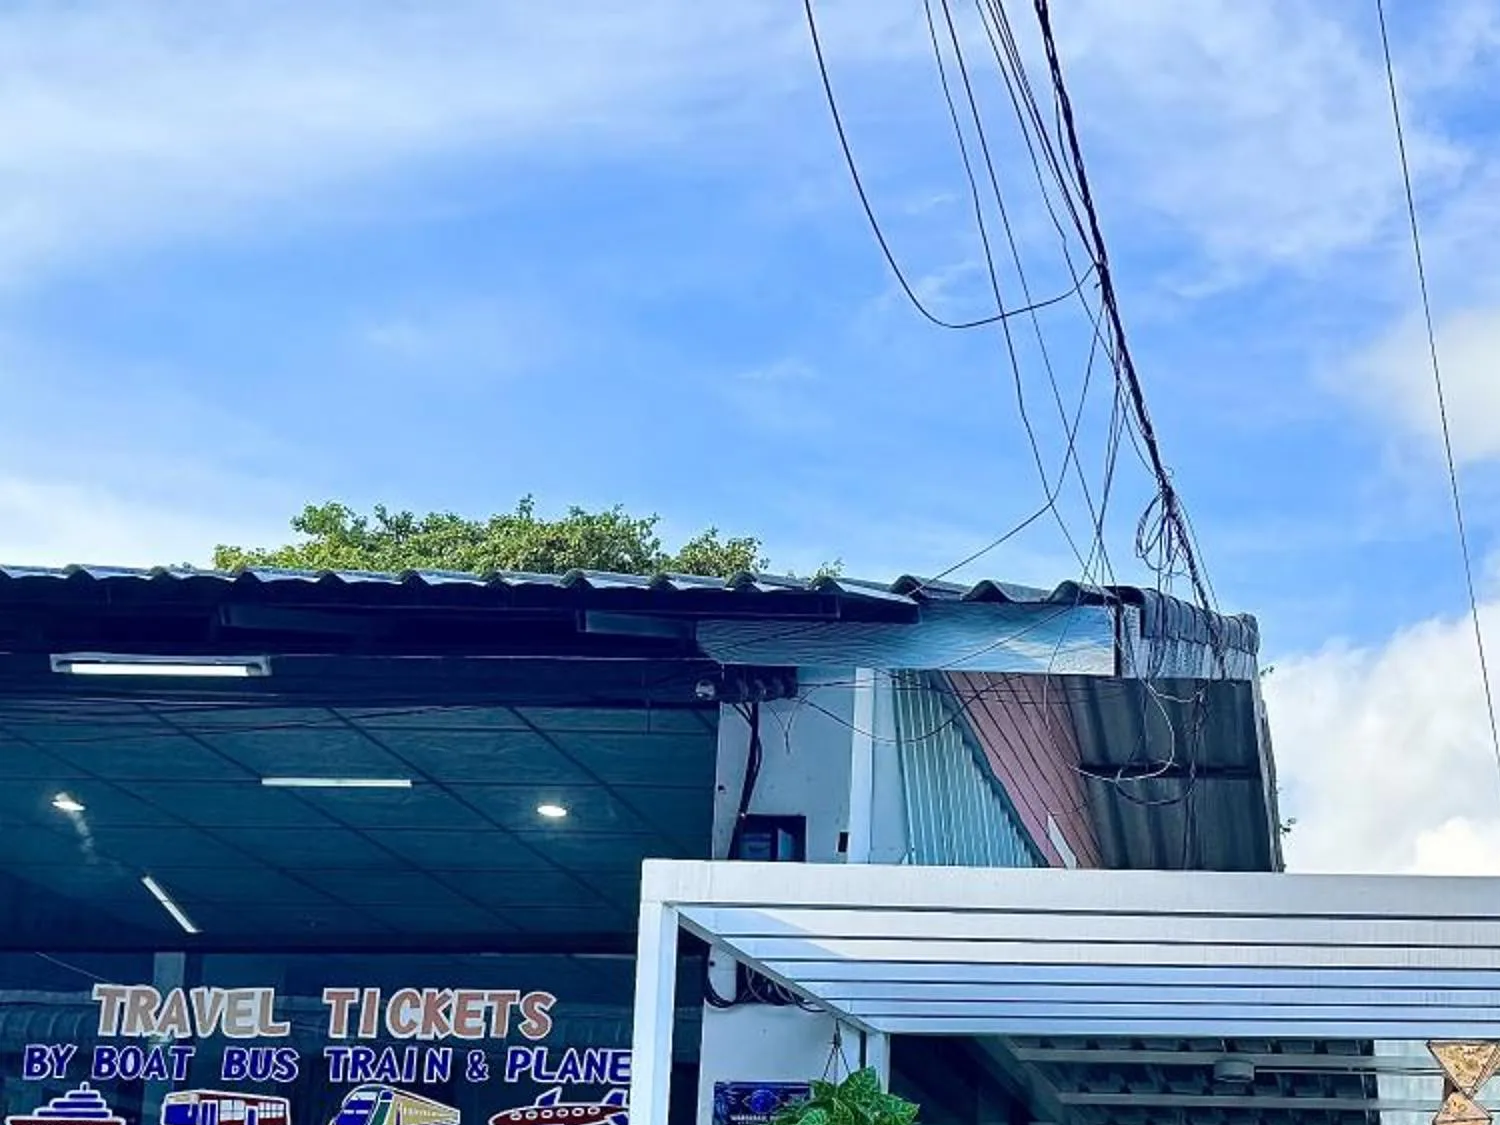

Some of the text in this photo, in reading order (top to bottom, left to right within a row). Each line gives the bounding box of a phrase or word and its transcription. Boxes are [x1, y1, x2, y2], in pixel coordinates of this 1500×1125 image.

[92, 983, 557, 1040] TRAVEL TICKETS
[23, 1044, 632, 1083] BY BOAT BUS TRAIN & PLANE
